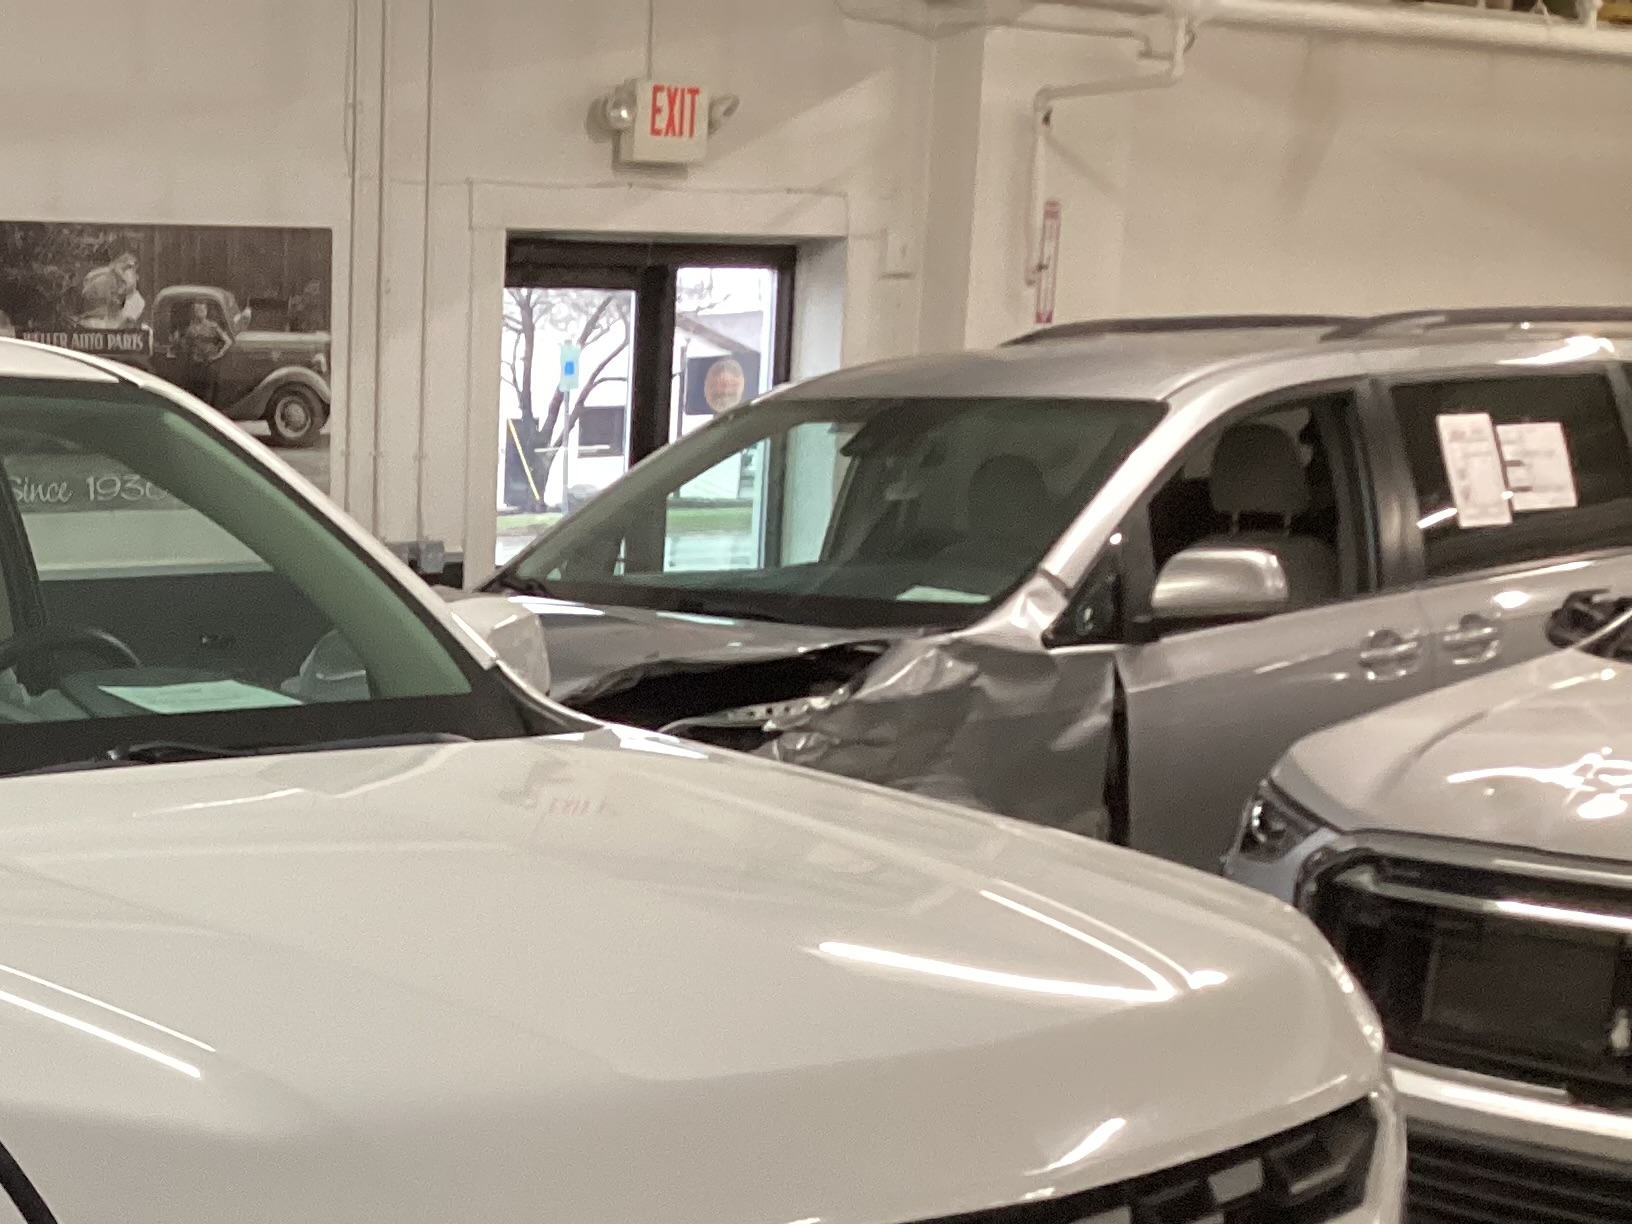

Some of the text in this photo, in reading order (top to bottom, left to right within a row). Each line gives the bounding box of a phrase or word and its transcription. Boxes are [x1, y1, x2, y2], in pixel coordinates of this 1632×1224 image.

[650, 84, 701, 138] EXIT
[71, 333, 104, 350] AUTO
[107, 332, 144, 350] PARTS
[8, 474, 74, 504] Since
